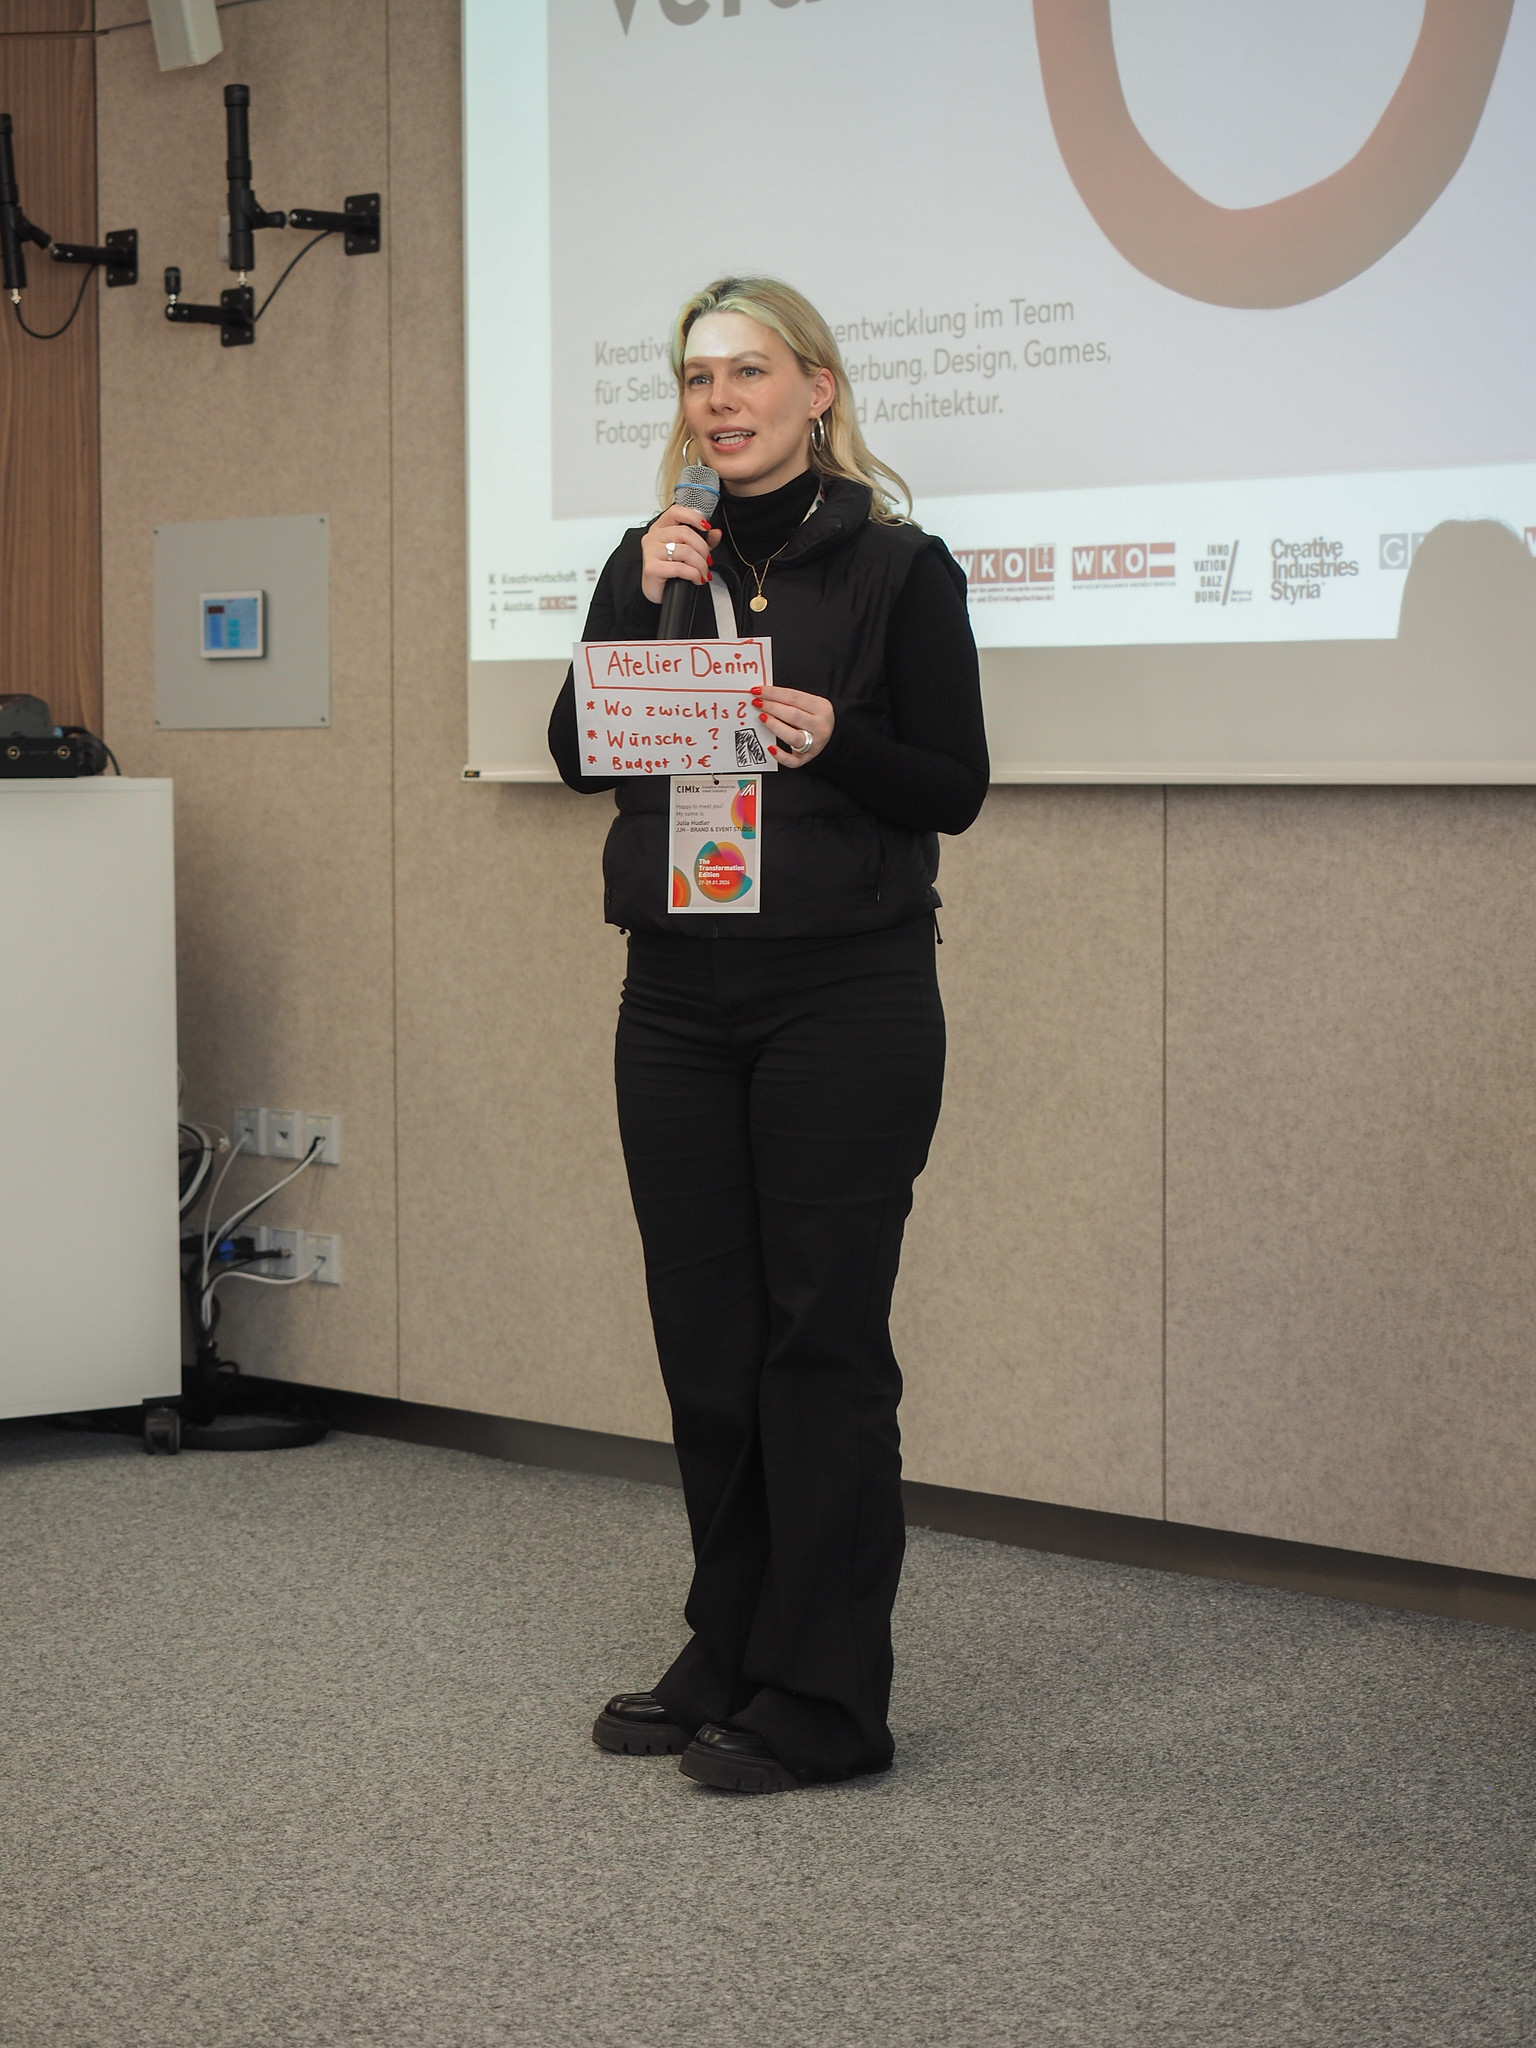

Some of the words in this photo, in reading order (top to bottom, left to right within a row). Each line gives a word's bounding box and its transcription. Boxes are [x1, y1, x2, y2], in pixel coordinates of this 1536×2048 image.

[831, 307, 966, 343] entwicklung
[975, 303, 1003, 329] im
[1010, 298, 1074, 325] Team
[842, 353, 927, 385] erbung,
[934, 345, 1017, 380] Design,
[1024, 339, 1112, 367] Games,
[595, 379, 621, 405] für
[874, 389, 1004, 423] Architektur.
[1207, 544, 1229, 556] INNO
[1271, 537, 1343, 561] Creative
[1073, 547, 1144, 577] WKO
[1194, 559, 1227, 572] VATION
[1272, 557, 1359, 580] Industries
[1200, 575, 1223, 588] SALZ
[1271, 579, 1321, 605] Styria
[1195, 591, 1220, 603] BURG
[607, 651, 682, 677] Atelier
[690, 646, 759, 677] Denim
[604, 699, 632, 717] Wo
[607, 729, 697, 749] Wünsche
[612, 756, 670, 773] Budget
[676, 785, 700, 794] CIMIx
